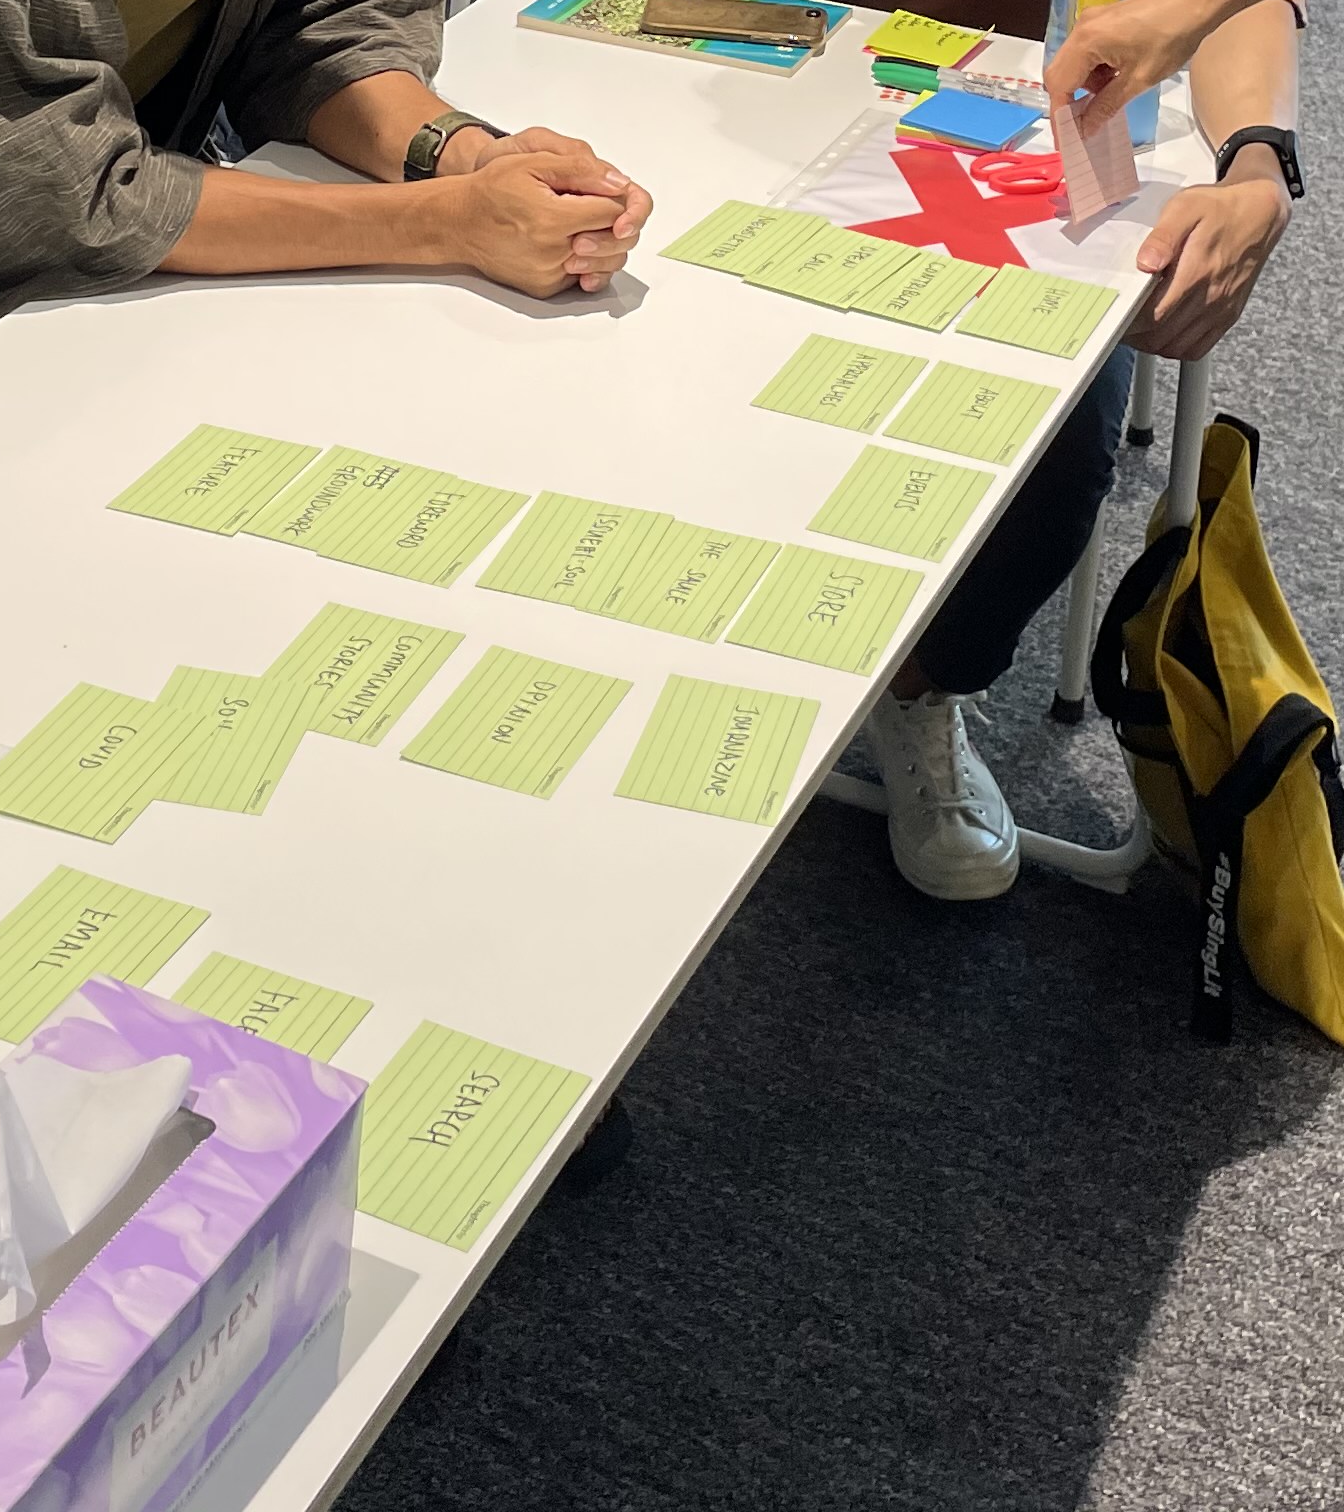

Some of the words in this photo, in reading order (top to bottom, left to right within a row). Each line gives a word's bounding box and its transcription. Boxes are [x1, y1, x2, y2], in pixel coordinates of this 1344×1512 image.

[798, 253, 832, 272] CALL
[842, 246, 879, 268] OPEN
[1032, 288, 1070, 315] HOME
[961, 387, 999, 420] ABOUT
[184, 446, 263, 496] FEATURE
[894, 470, 939, 512] EVENTS
[281, 465, 366, 536] GROUNDWORK
[395, 491, 467, 549] FOREWORD
[699, 540, 732, 560] THE
[665, 568, 707, 606] SAUCE
[807, 571, 865, 627] STORE
[313, 635, 373, 689] STORIES
[331, 635, 423, 725] COMMUNITY
[491, 680, 557, 744] OPINION
[78, 724, 138, 769] COVID
[28, 907, 118, 972] EMAIL
[408, 1069, 501, 1148] SEARCH
[130, 1283, 260, 1459] BEAUTEX
